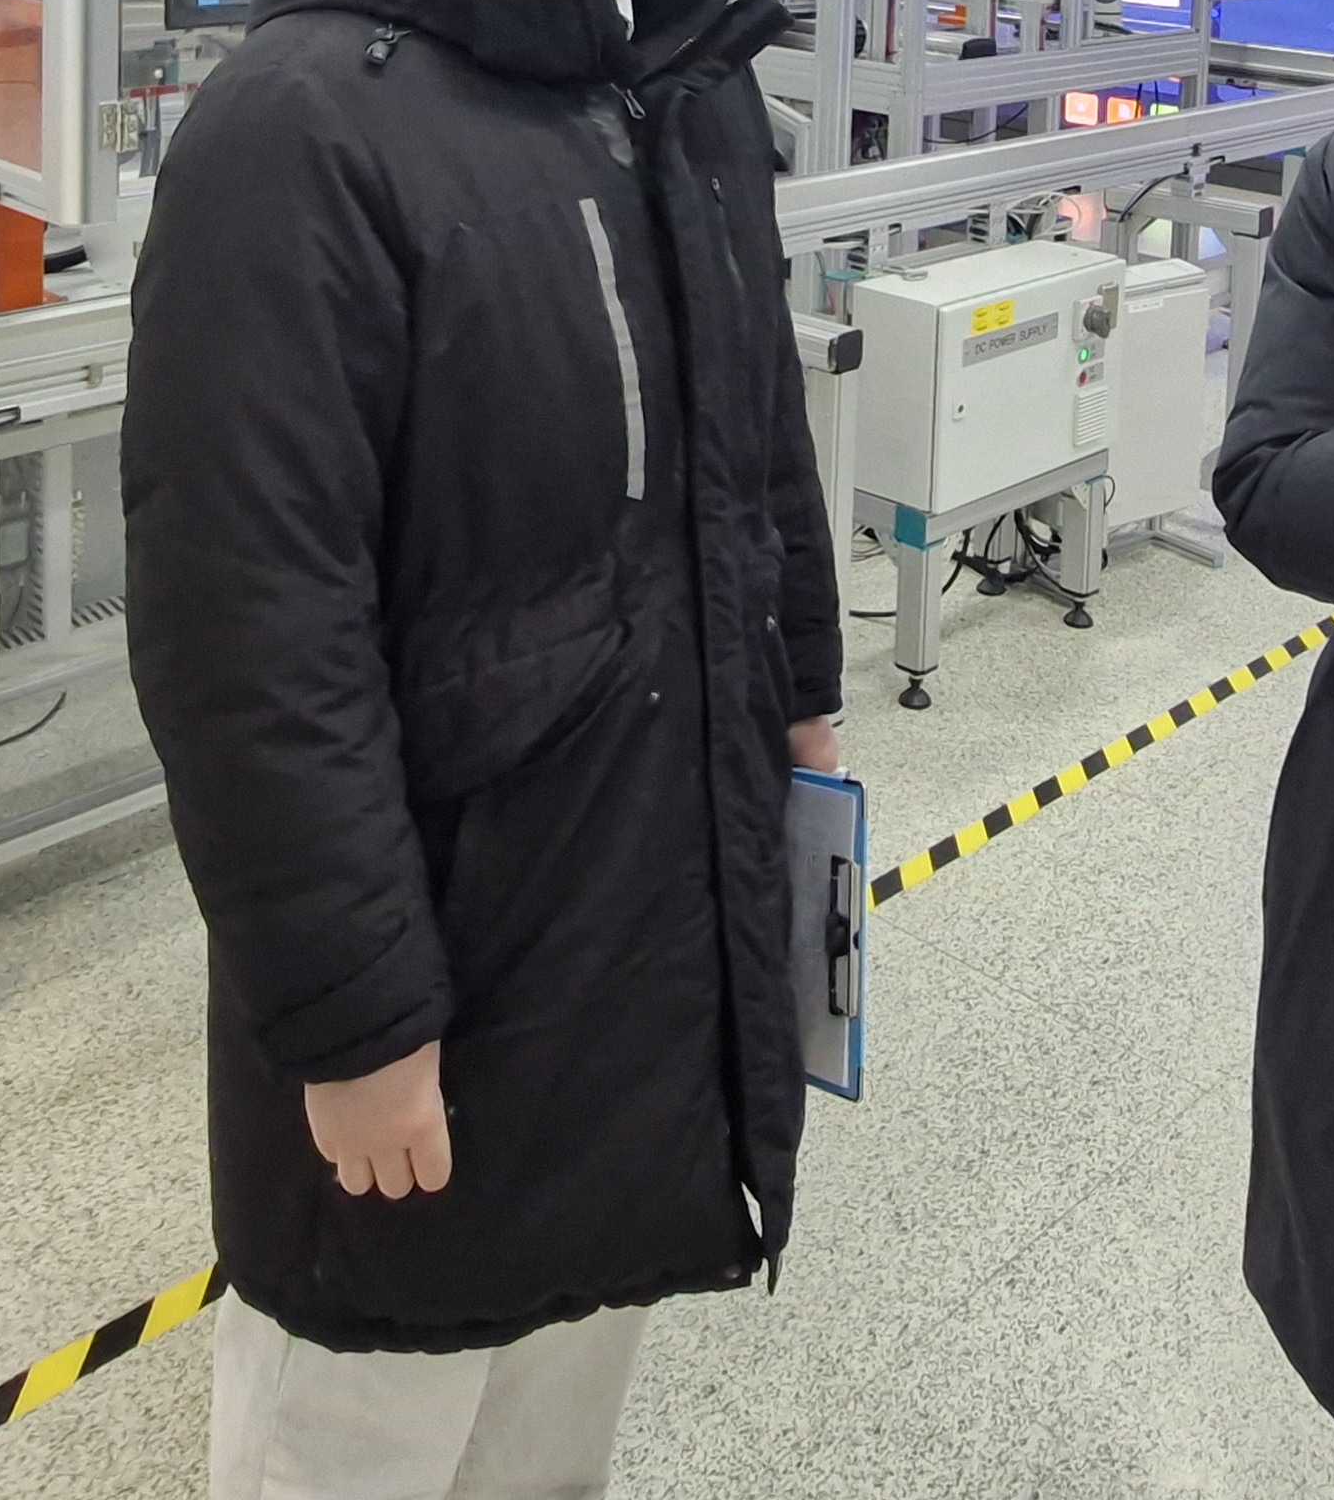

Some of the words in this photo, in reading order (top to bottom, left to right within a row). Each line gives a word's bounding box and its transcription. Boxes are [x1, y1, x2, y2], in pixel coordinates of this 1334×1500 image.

[975, 341, 987, 355] DC
[989, 333, 1017, 350] POWER
[1019, 325, 1048, 342] SUPPLY
